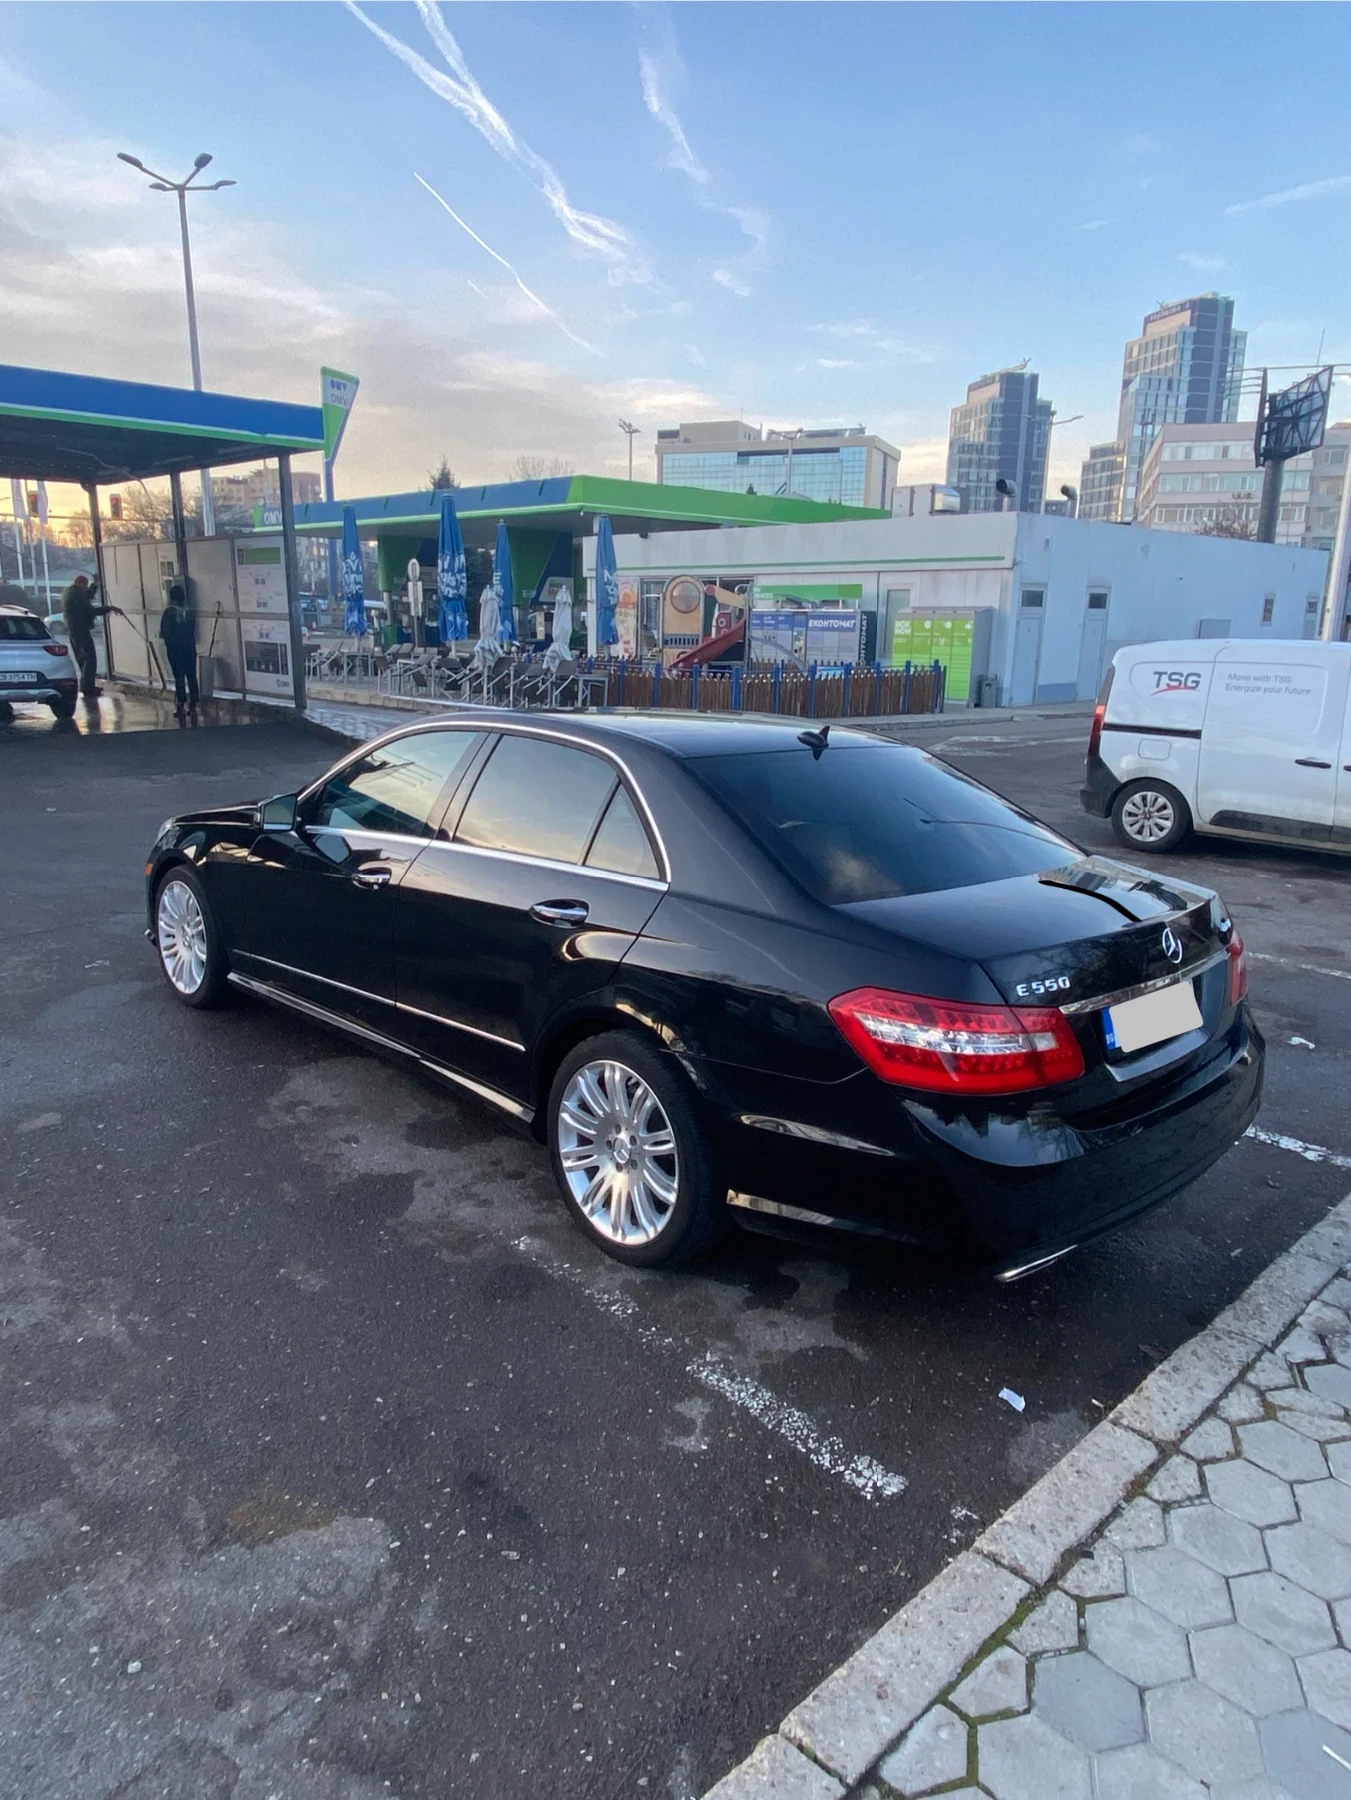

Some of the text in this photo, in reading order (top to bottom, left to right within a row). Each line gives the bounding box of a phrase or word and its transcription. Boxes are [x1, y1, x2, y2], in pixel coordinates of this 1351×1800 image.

[808, 619, 856, 628] ЕКОНТОМАТ
[1153, 671, 1201, 690] TSG
[1228, 673, 1251, 681] Move
[1253, 674, 1271, 682] with
[1225, 683, 1312, 695] Energize your future
[1016, 976, 1071, 997] E 550
